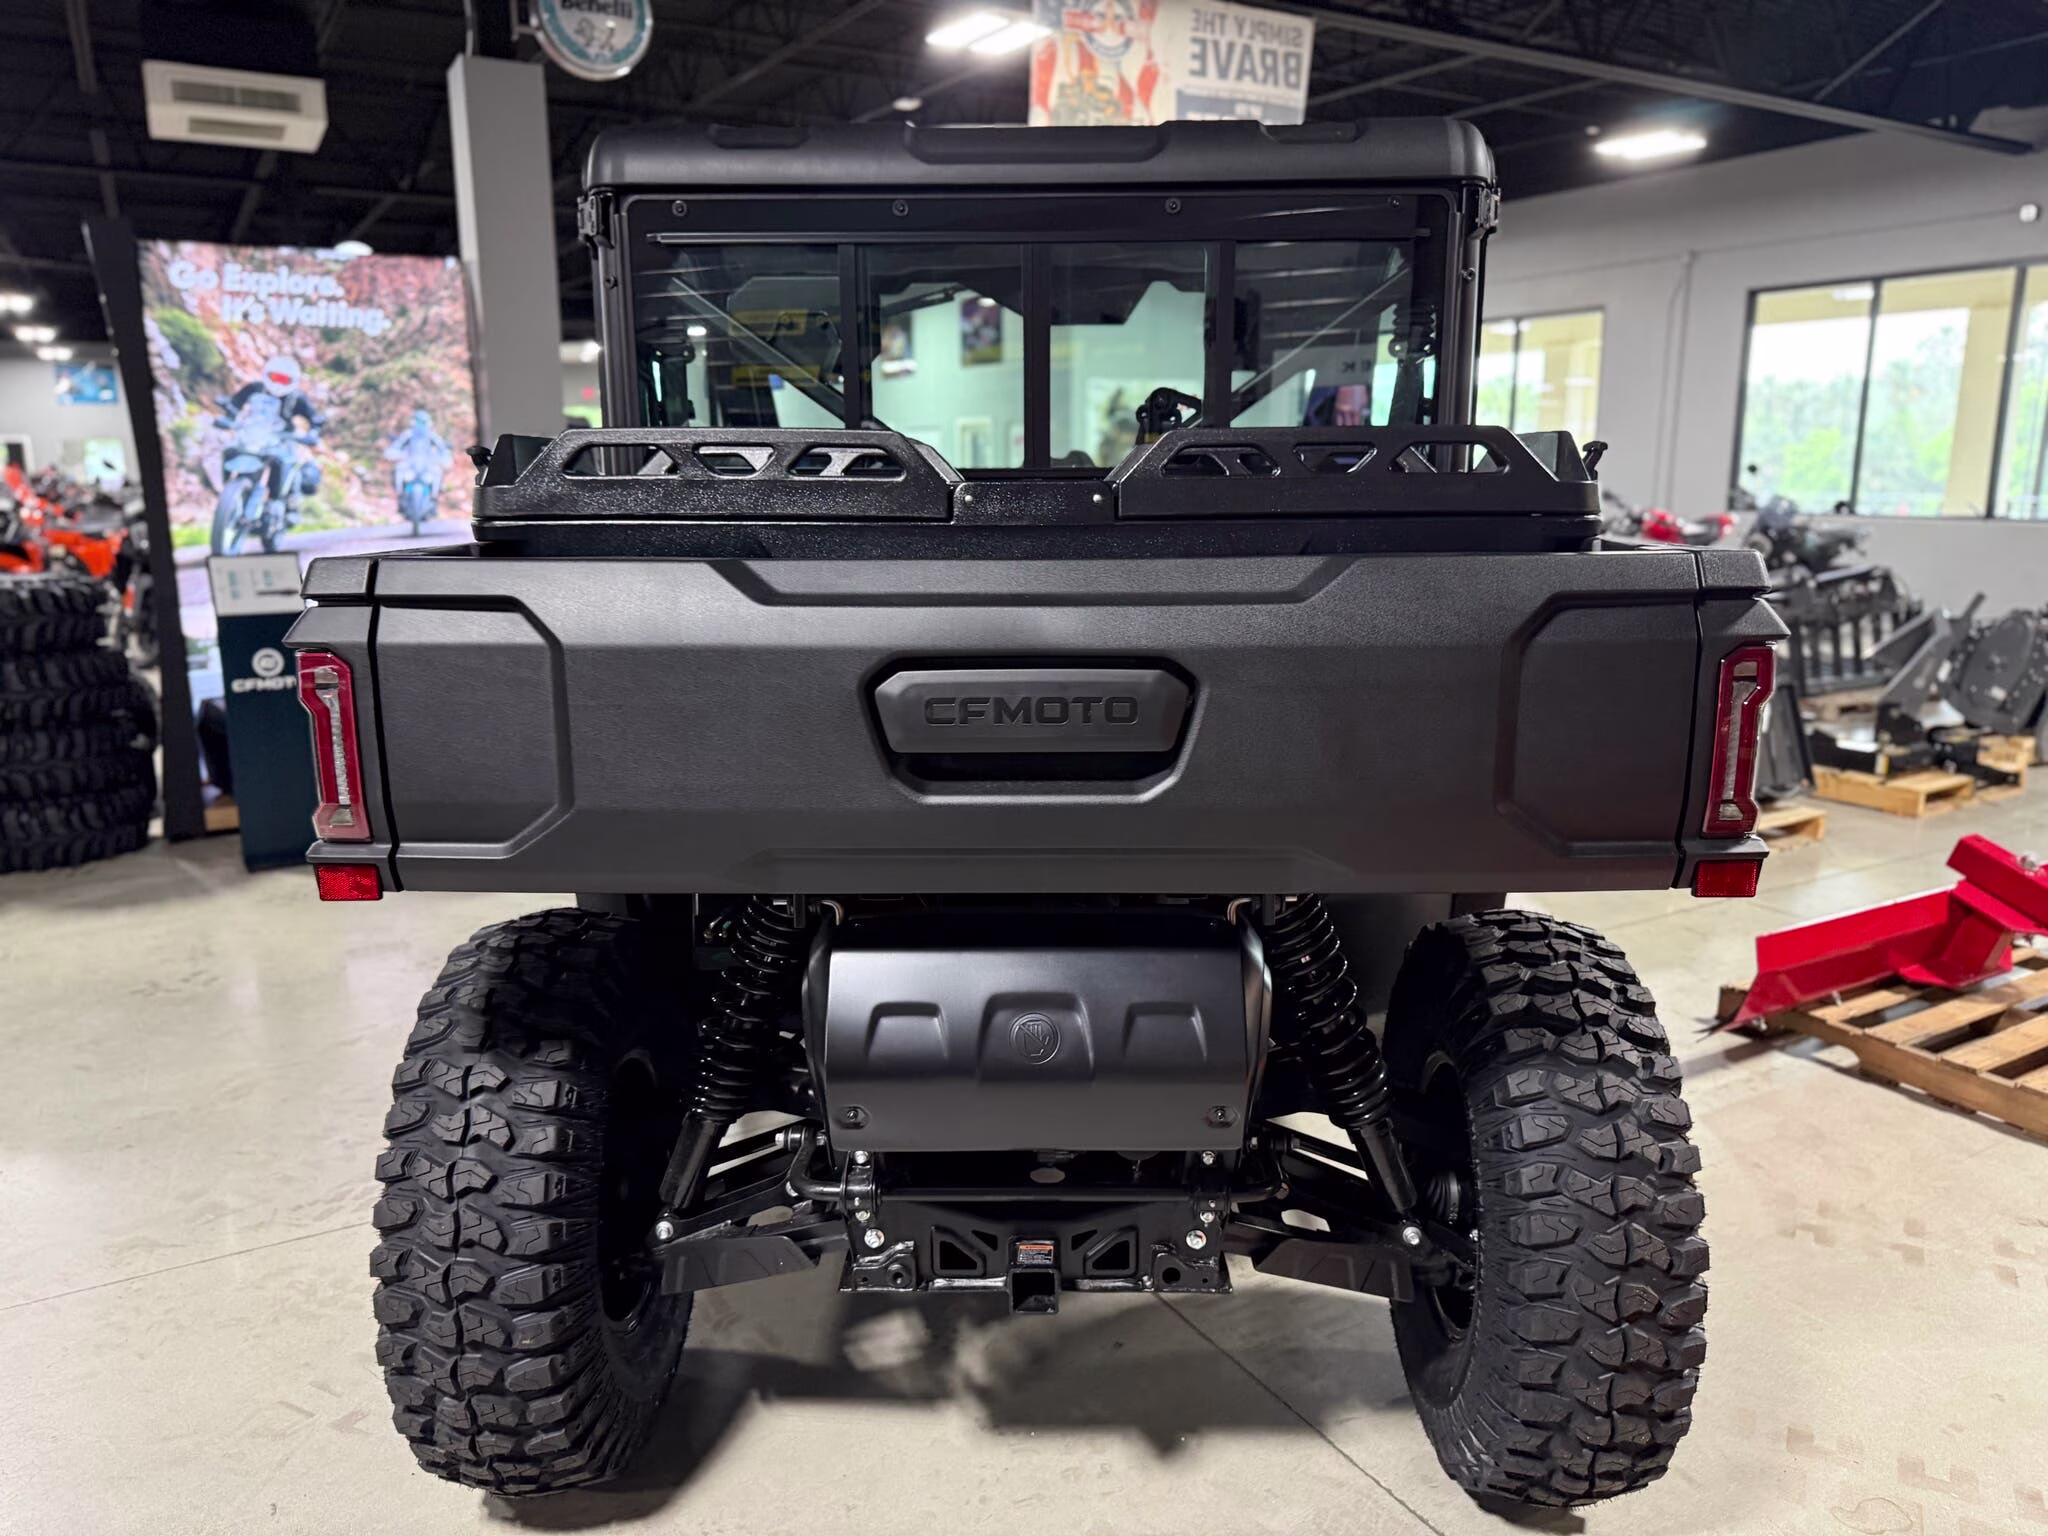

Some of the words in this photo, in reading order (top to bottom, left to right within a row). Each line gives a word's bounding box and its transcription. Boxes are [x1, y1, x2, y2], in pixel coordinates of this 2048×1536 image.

[168, 259, 219, 290] Go
[222, 262, 345, 299] Explore.
[266, 299, 392, 337] Waiting.
[231, 676, 297, 693] CFMOT
[924, 696, 1139, 726] CFMOTO
